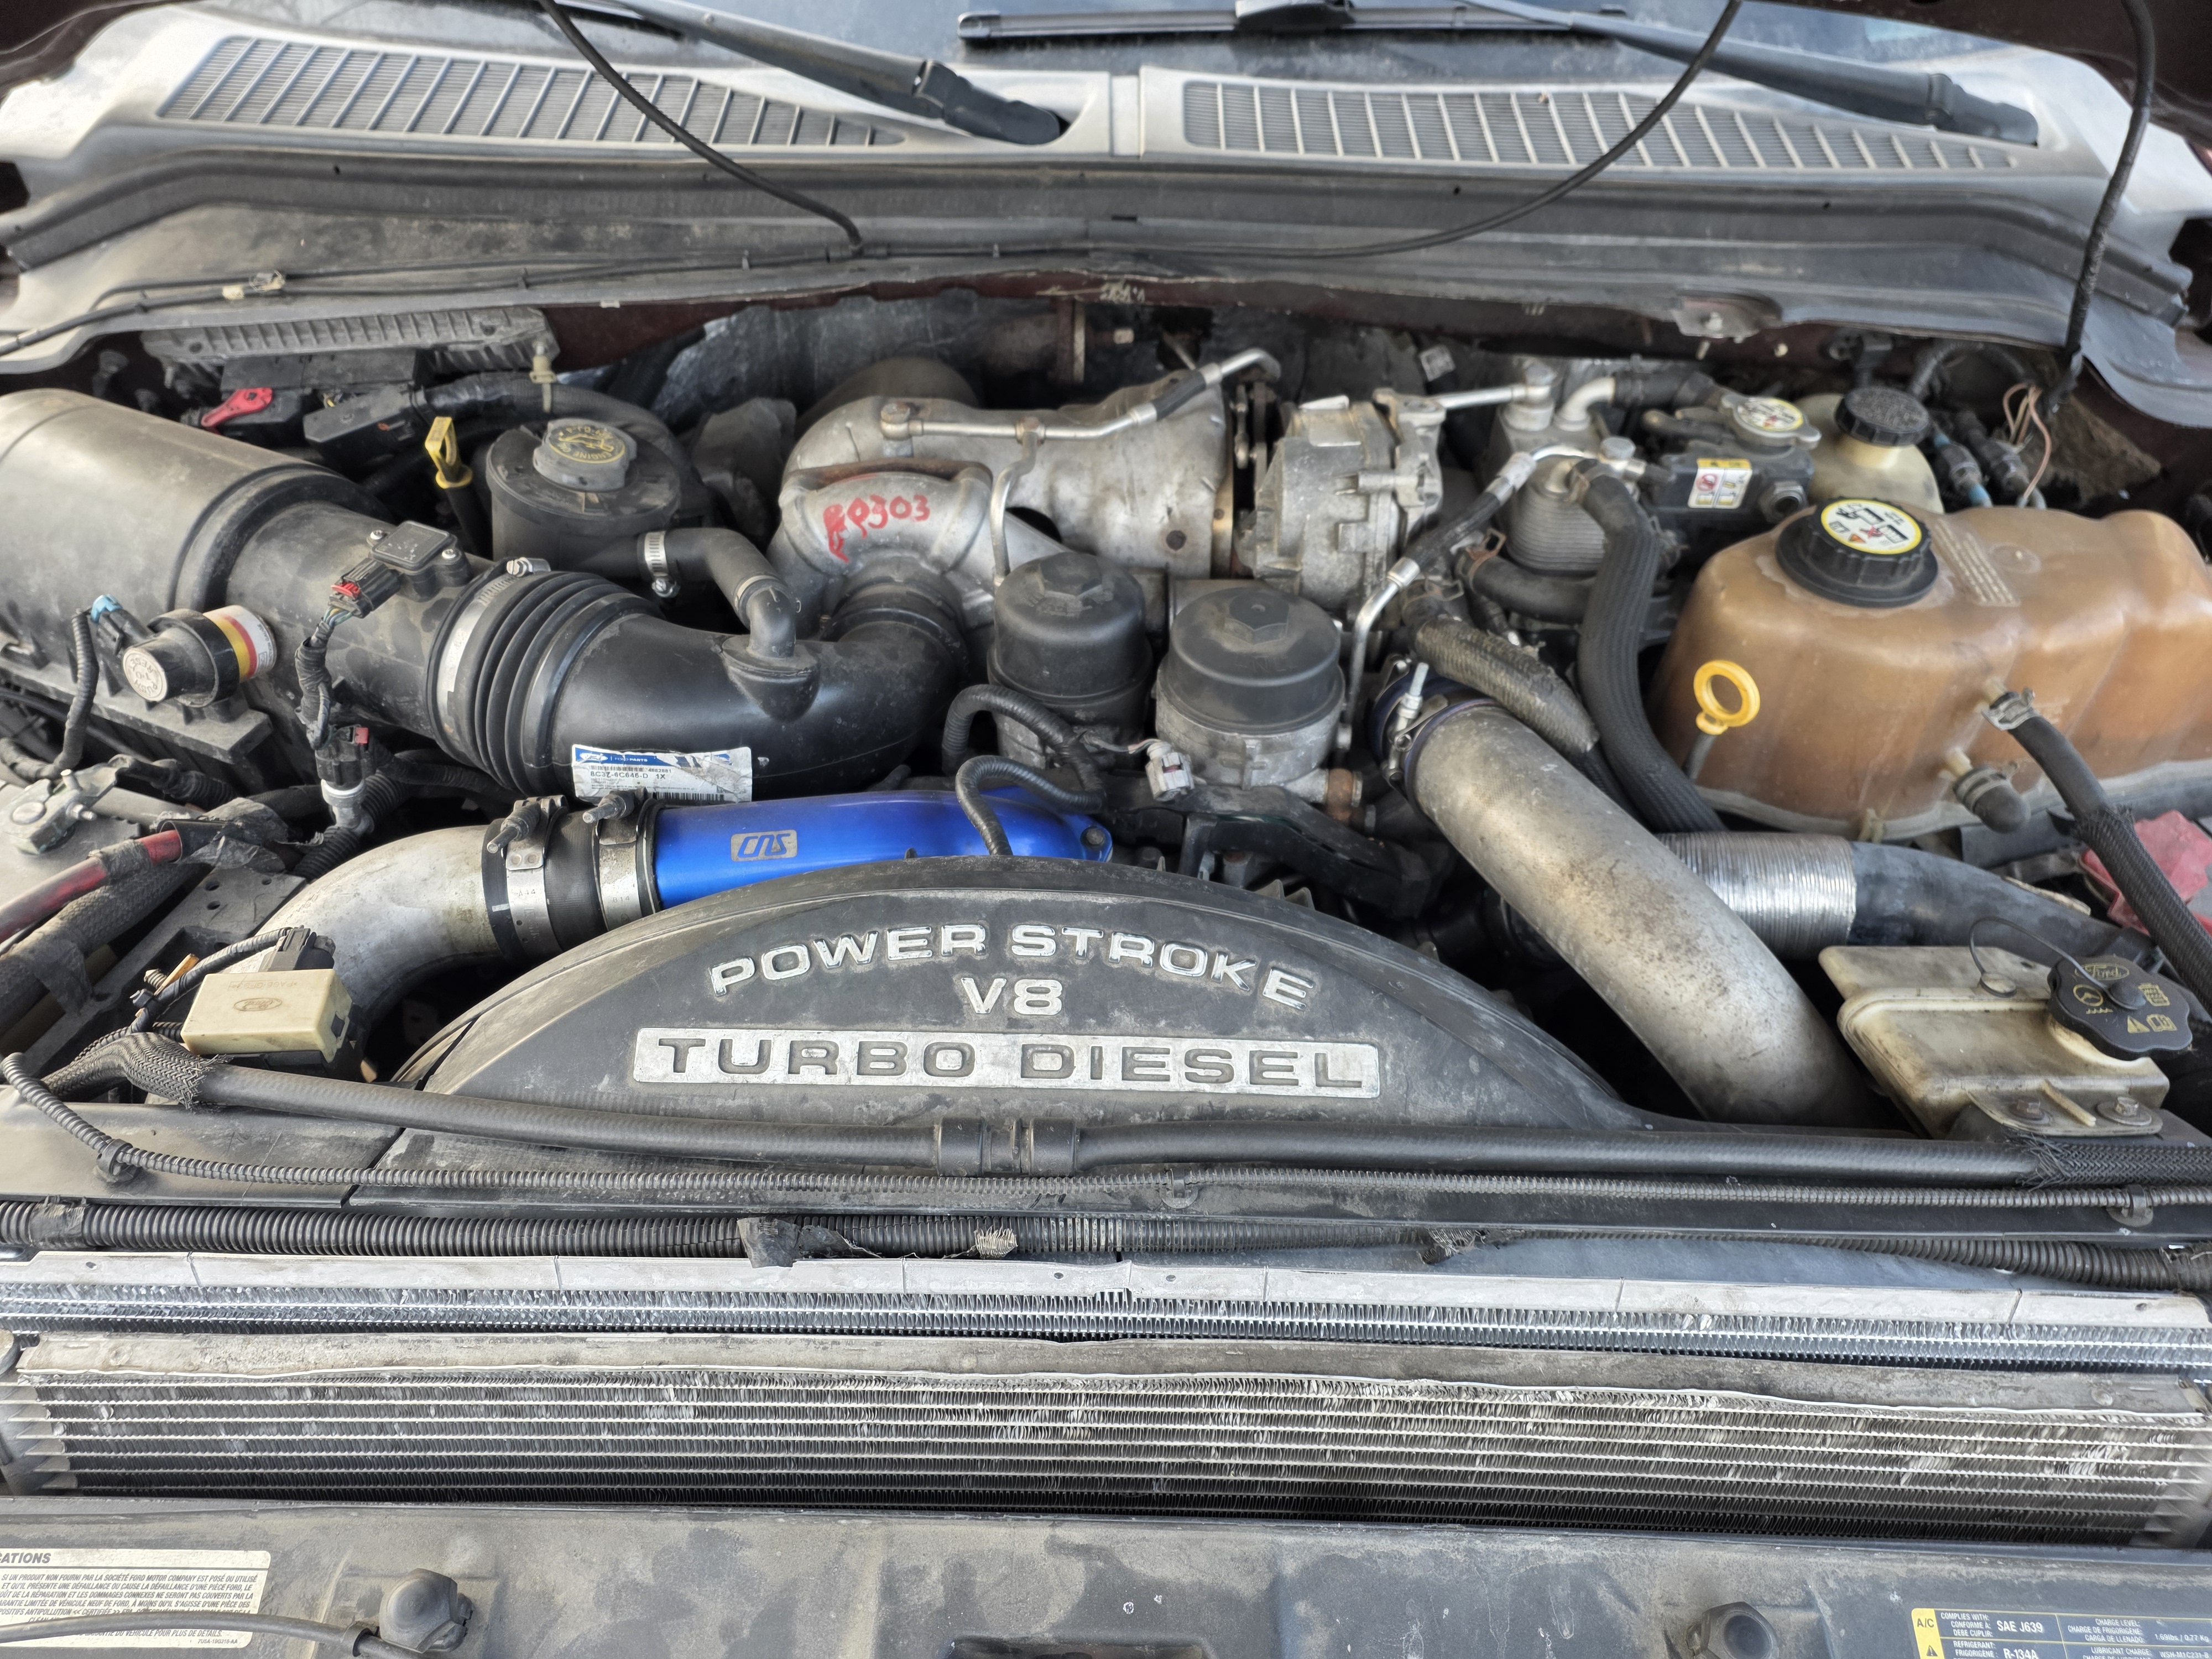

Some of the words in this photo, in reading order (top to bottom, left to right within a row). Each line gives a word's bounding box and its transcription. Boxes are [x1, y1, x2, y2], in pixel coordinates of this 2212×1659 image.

[710, 924, 986, 996] POWER
[1011, 924, 1314, 1011] STROKE
[961, 977, 1063, 1016] V8
[658, 1038, 977, 1079] TURBO
[1021, 1044, 1362, 1089] DIESEL
[0, 1552, 51, 1564] ATIONS
[104, 1573, 130, 1582] SOCIÉTÉ
[209, 1573, 227, 1583] POSÉ
[235, 1573, 258, 1583] UTILISÉ
[27, 1581, 58, 1590] PRÉSENTE
[71, 1581, 111, 1590] DÉFAILLANCE
[150, 1582, 189, 1590] DÉFAILLANCE
[208, 1582, 226, 1591] PIÈCE
[30, 1589, 67, 1598] RÉPARATION
[24, 1598, 47, 1606] LIMITÉE
[58, 1598, 87, 1607] VÉHICULE
[112, 1600, 130, 1608] FORD,
[220, 1599, 238, 1608] PIÈCE
[1940, 1612, 1970, 1621] COMPLIES
[1917, 1618, 1934, 1628] A/C
[1950, 1620, 1983, 1629] CONFORME
[1996, 1620, 2017, 1632] SAE
[2020, 1622, 2044, 1634] J639
[2095, 1618, 2119, 1626] CHARGE
[2067, 1625, 2091, 1633] CHARGE
[2085, 1634, 2106, 1642] CARGA
[1953, 1640, 1996, 1649] REFRIGERANT:
[2003, 1648, 2039, 1659] R-134A
[2125, 1648, 2152, 1656] CHARGE:
